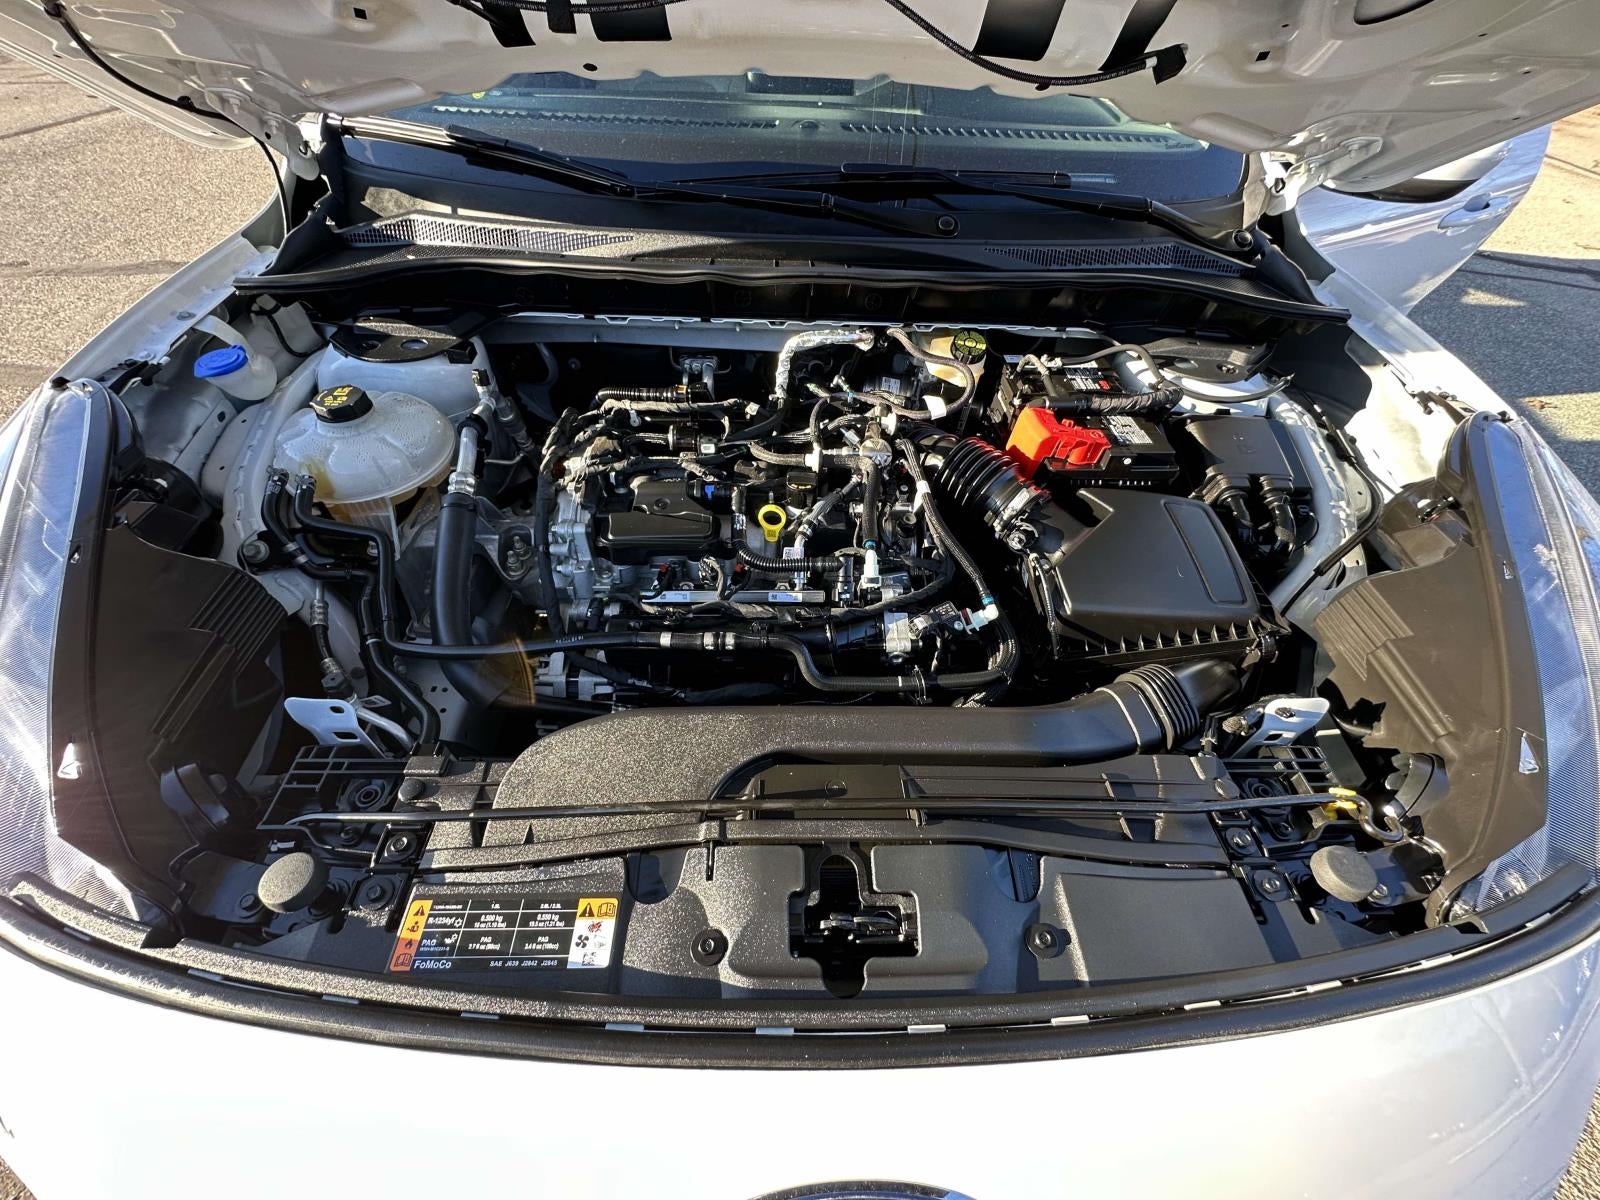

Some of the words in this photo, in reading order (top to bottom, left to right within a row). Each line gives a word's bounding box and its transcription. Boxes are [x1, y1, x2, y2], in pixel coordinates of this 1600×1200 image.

[427, 916, 456, 926] R-1234yf
[495, 914, 504, 922] kg
[552, 914, 560, 922] kg
[414, 960, 452, 969] FoMoCo
